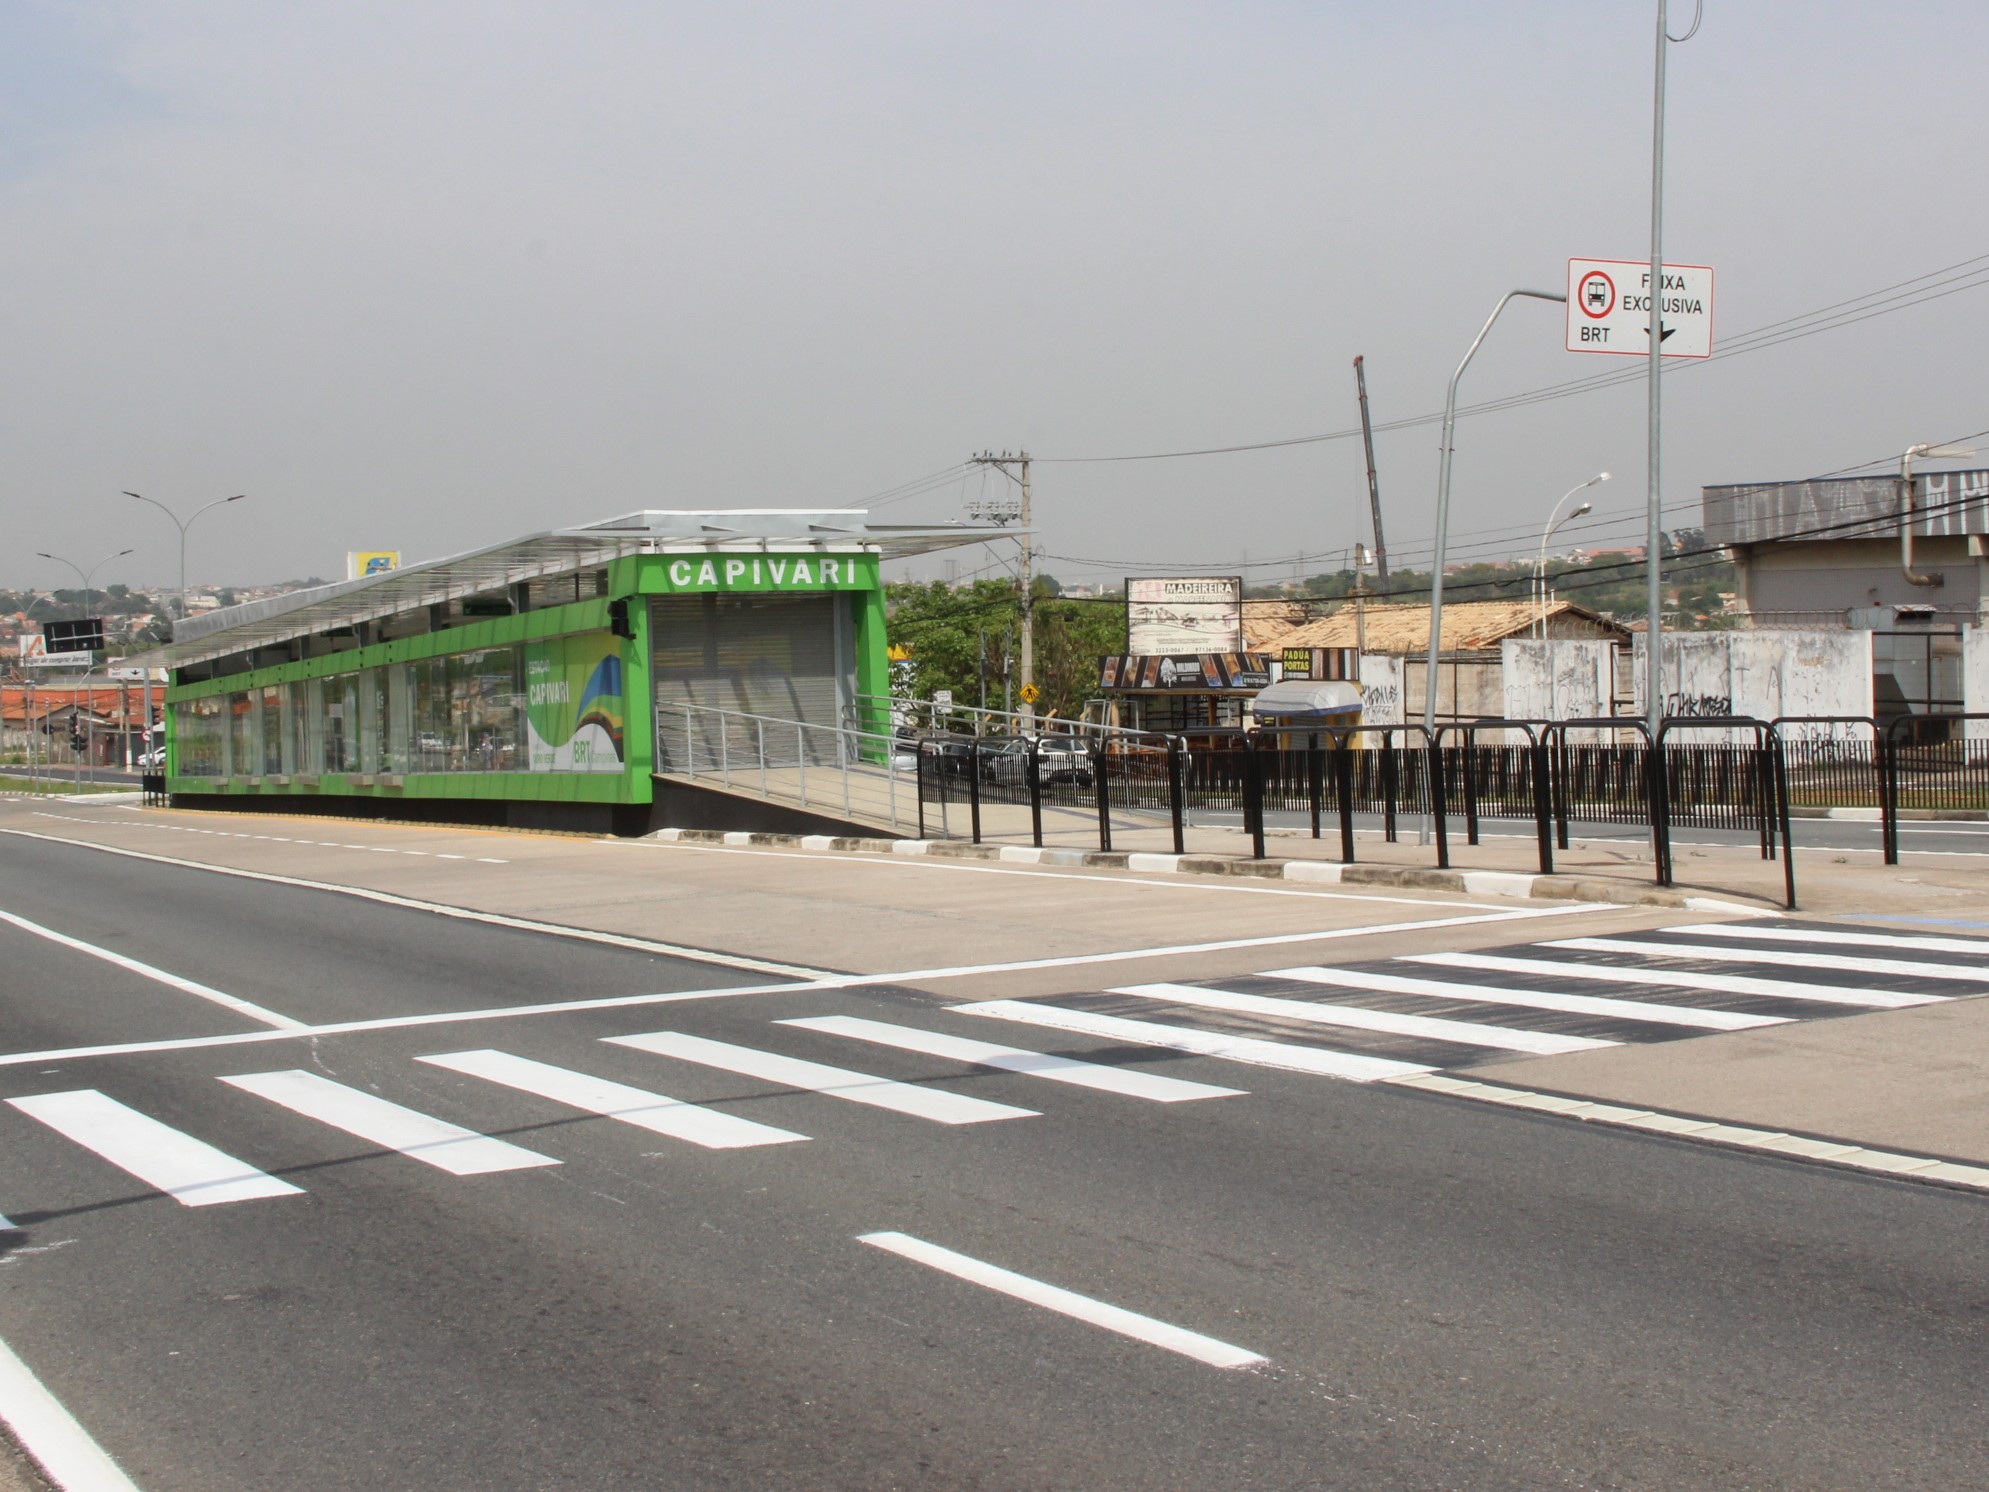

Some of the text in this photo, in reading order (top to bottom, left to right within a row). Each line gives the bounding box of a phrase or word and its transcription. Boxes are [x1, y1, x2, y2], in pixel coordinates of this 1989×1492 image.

[1641, 273, 1686, 291] FIXA
[1623, 295, 1703, 315] EXCUSIVA
[1580, 326, 1611, 343] BRT
[669, 558, 855, 586] CAPIVARI
[1165, 583, 1234, 595] MADEIREIRA
[1283, 649, 1310, 660] PADÚA
[1283, 661, 1310, 671] PORTAS
[529, 681, 569, 706] CAPIVARI
[573, 741, 591, 763] BRT
